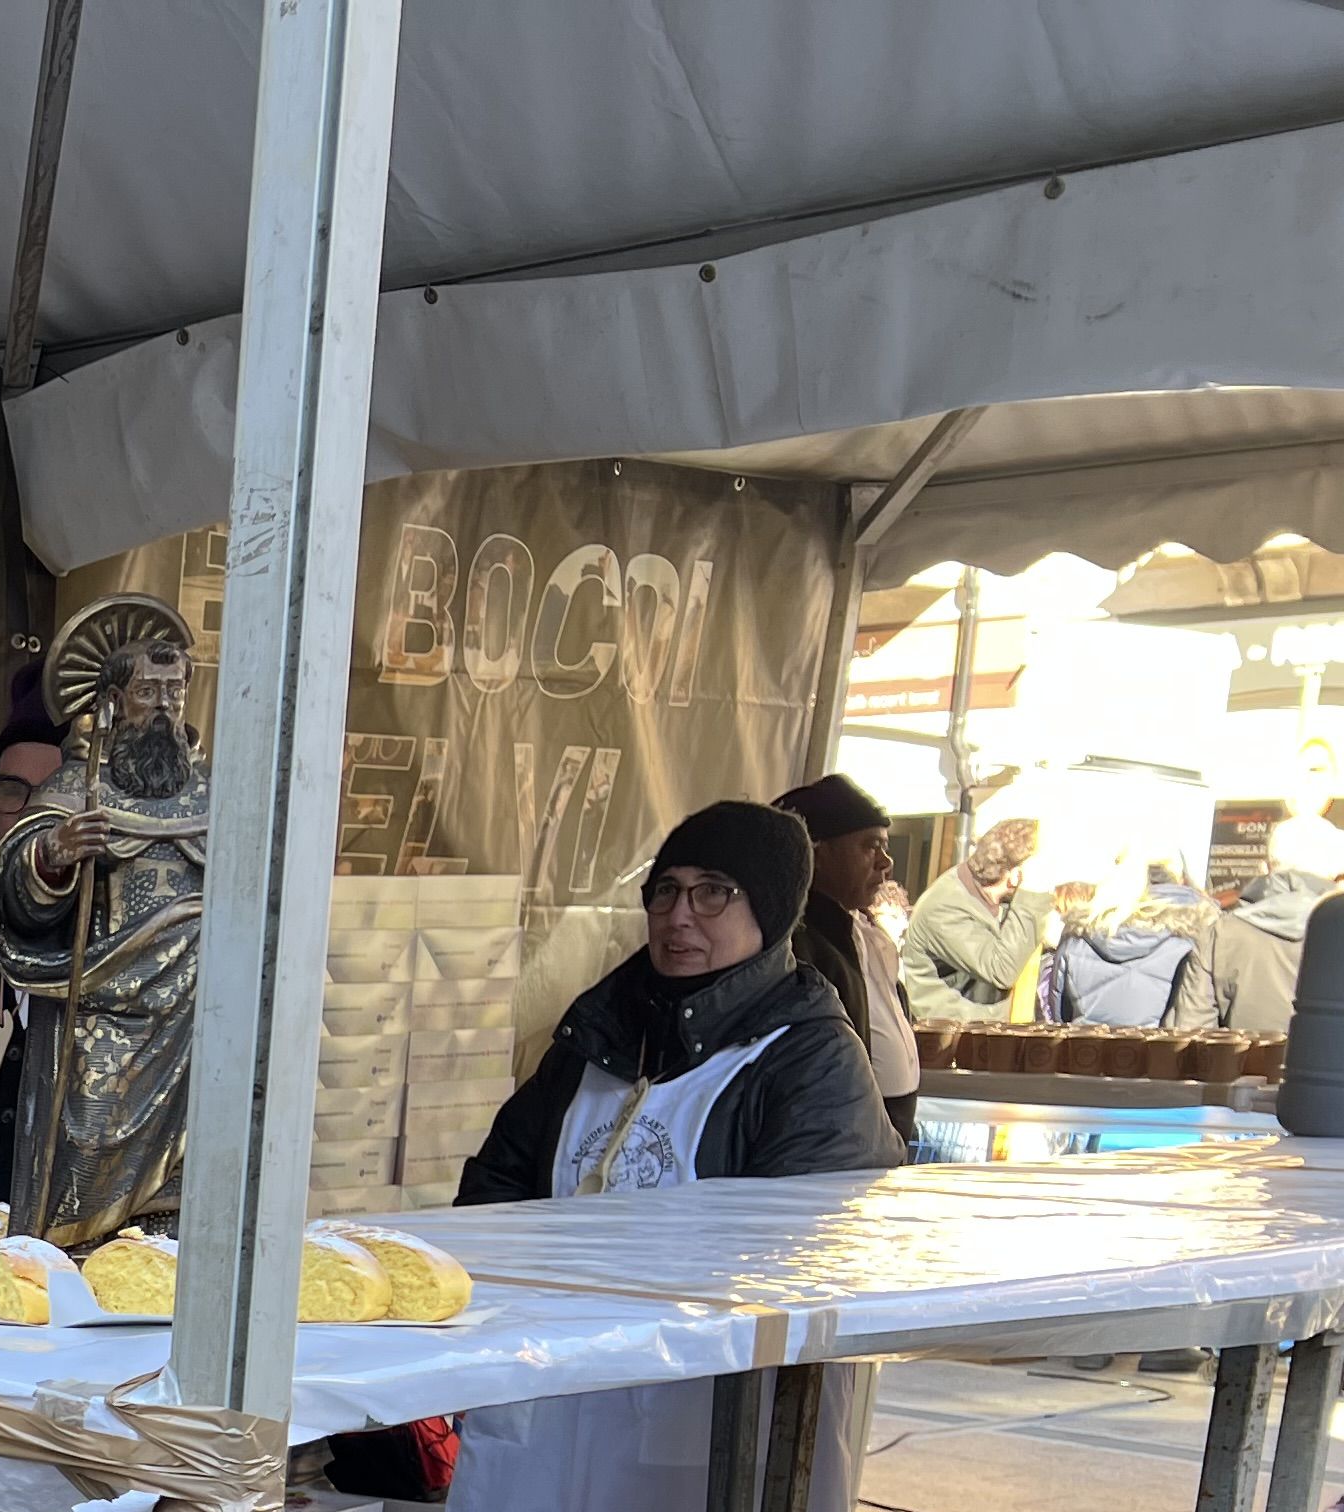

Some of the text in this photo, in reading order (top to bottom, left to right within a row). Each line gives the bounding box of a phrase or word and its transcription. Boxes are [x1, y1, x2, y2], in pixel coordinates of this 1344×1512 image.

[377, 523, 714, 707] BOCOI
[514, 742, 622, 893] VI
[571, 1120, 615, 1164] ESCUDELL
